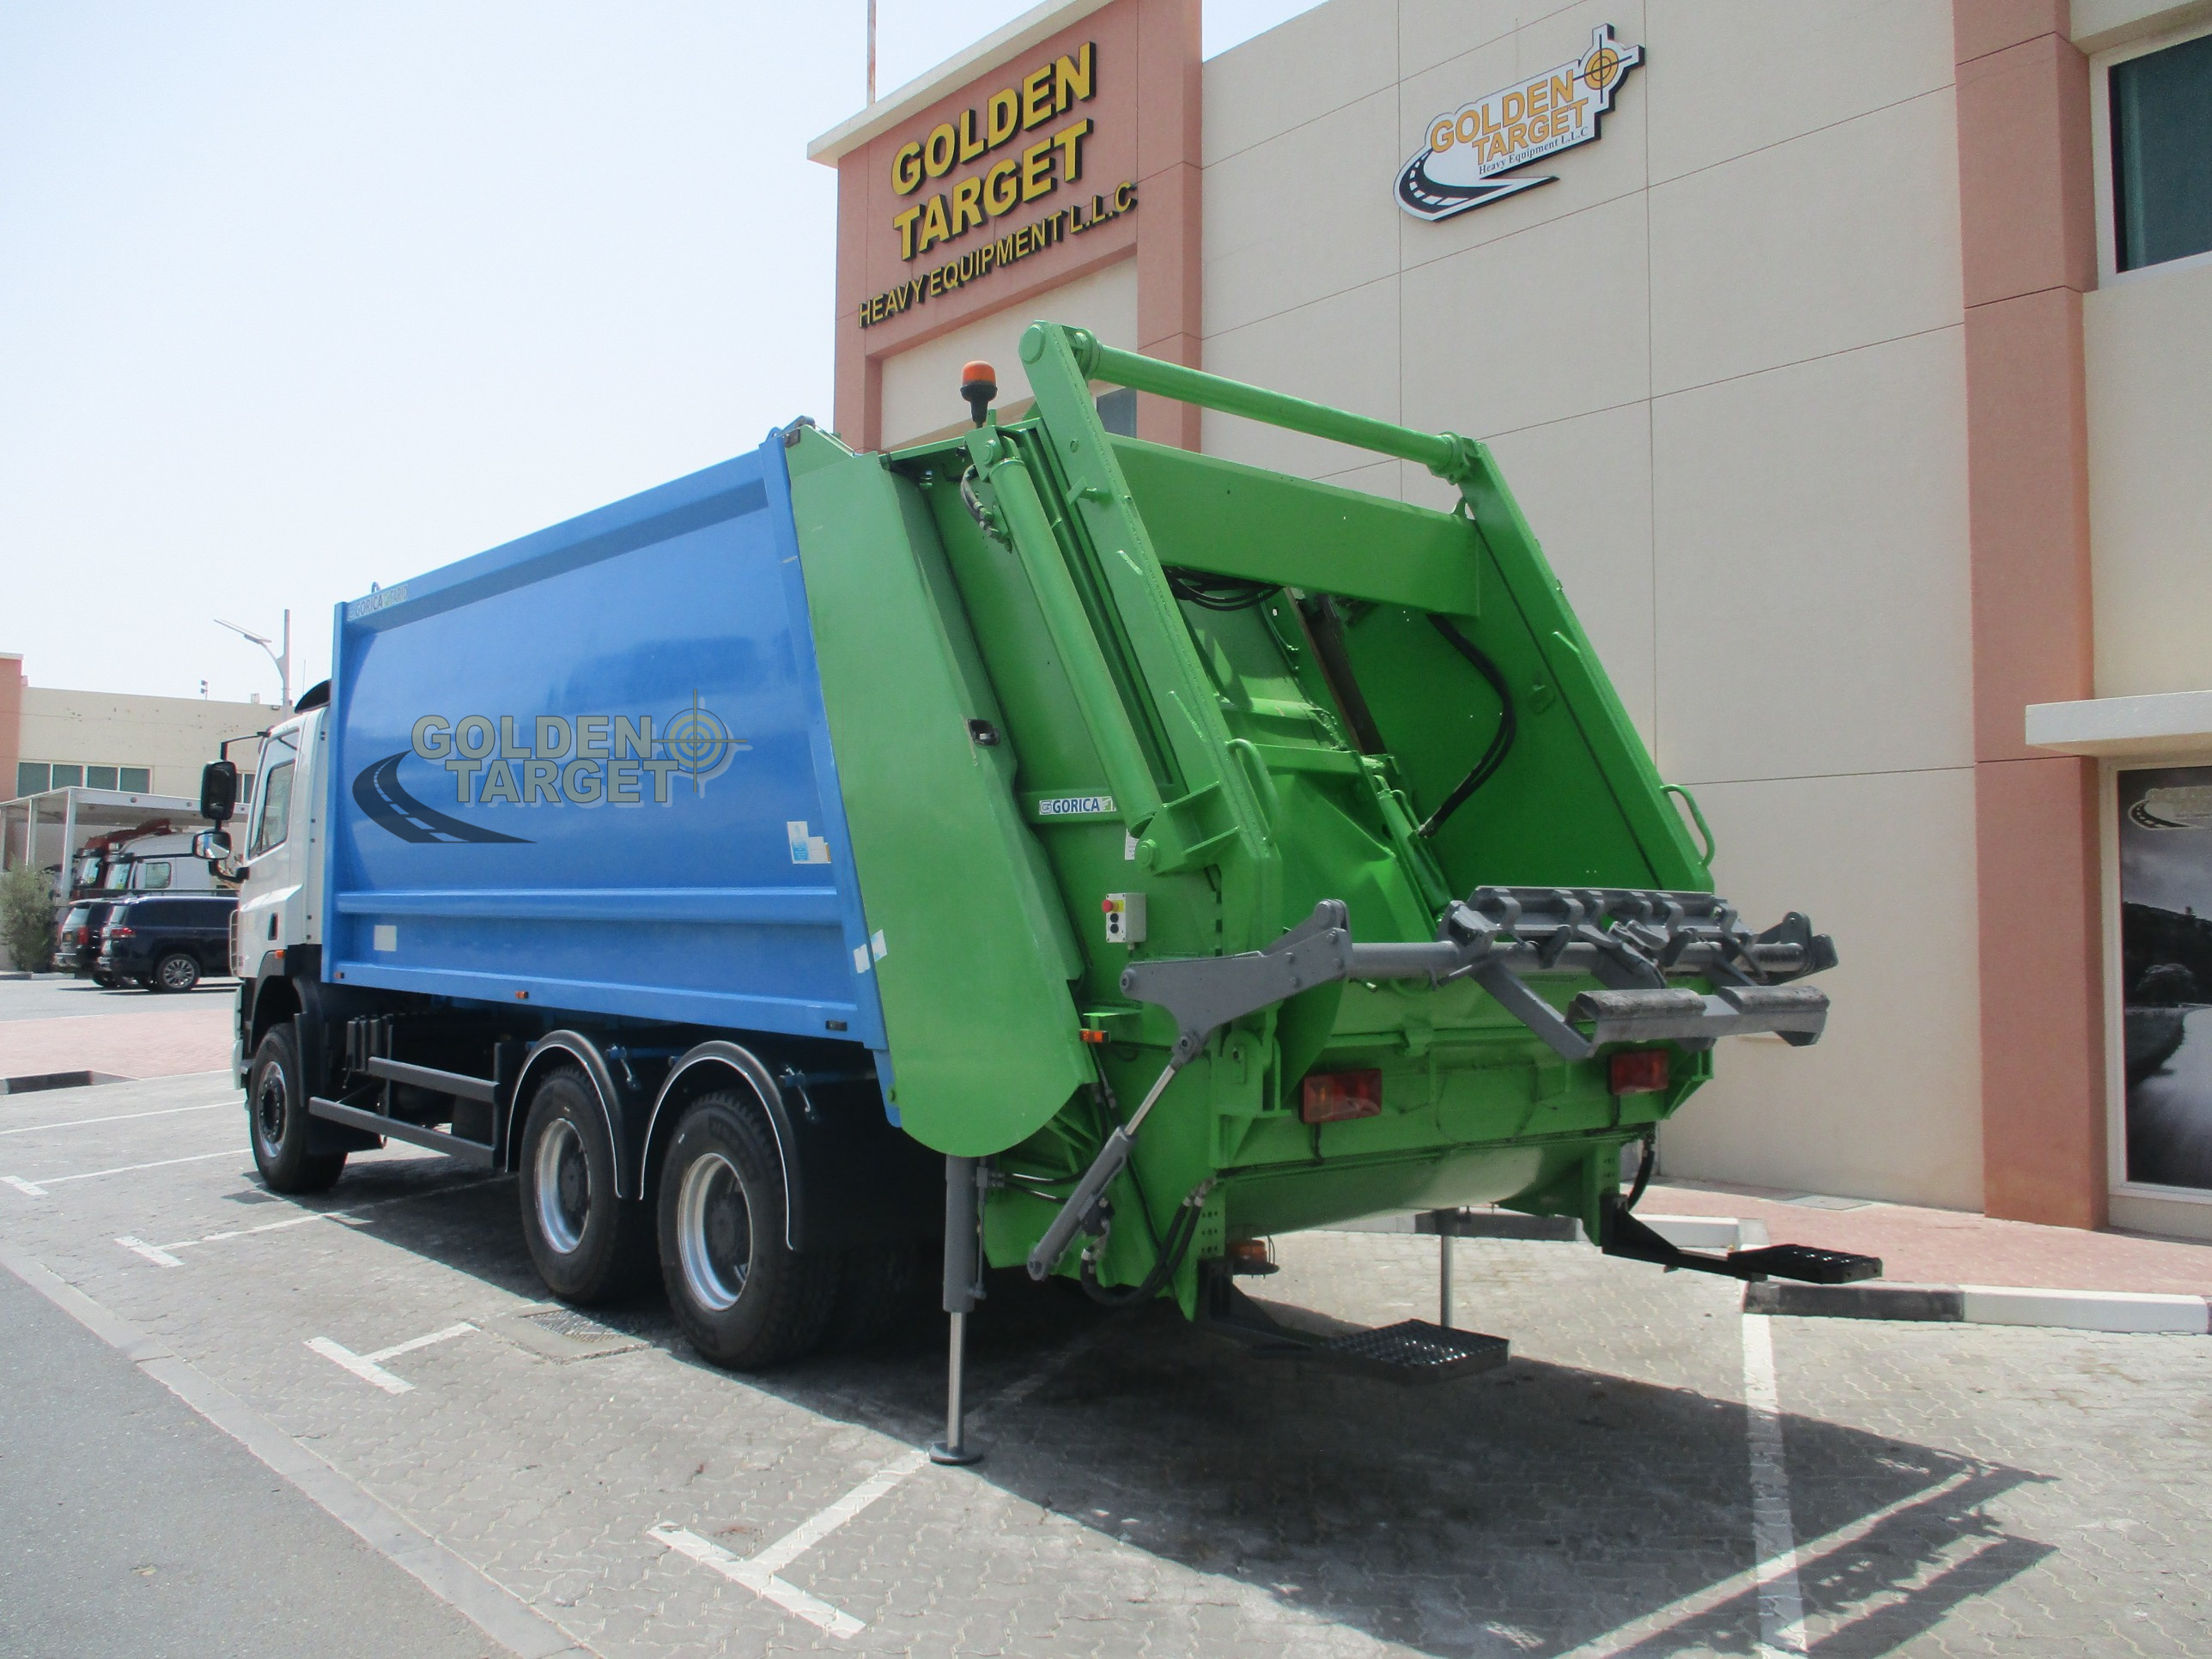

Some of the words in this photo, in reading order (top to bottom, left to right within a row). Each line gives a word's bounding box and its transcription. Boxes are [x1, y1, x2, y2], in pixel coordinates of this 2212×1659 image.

[891, 41, 1095, 197] GOLDEN
[1431, 70, 1573, 153] GOLDEN
[1472, 97, 1589, 165] TARGET
[1479, 159, 1506, 175] Heavy
[1509, 139, 1559, 163] Equipment
[893, 118, 1093, 261] TARGET
[859, 275, 929, 328] HEAVY
[930, 210, 1067, 298] EQUIPMENT
[1070, 181, 1137, 235] L.L.C
[355, 594, 383, 617] GORICA
[410, 714, 653, 760] GOLDEN
[445, 759, 679, 804] TARGET
[1053, 798, 1100, 813] GORICA
